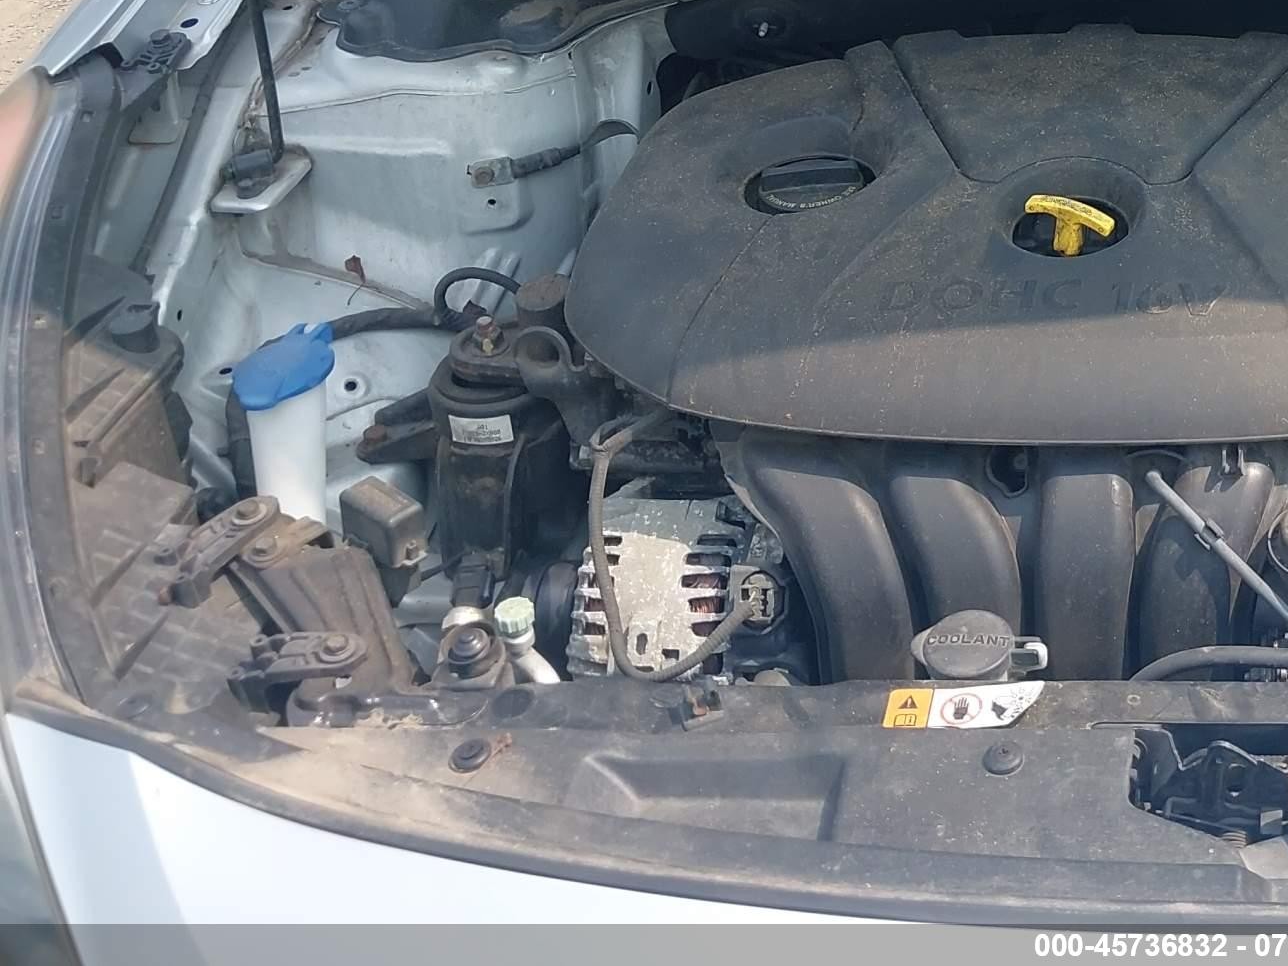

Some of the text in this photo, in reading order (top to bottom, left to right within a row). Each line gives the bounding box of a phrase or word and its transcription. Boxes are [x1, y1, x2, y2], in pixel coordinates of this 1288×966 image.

[880, 278, 1228, 317] DOHC 16V
[926, 633, 1011, 648] COOLANT
